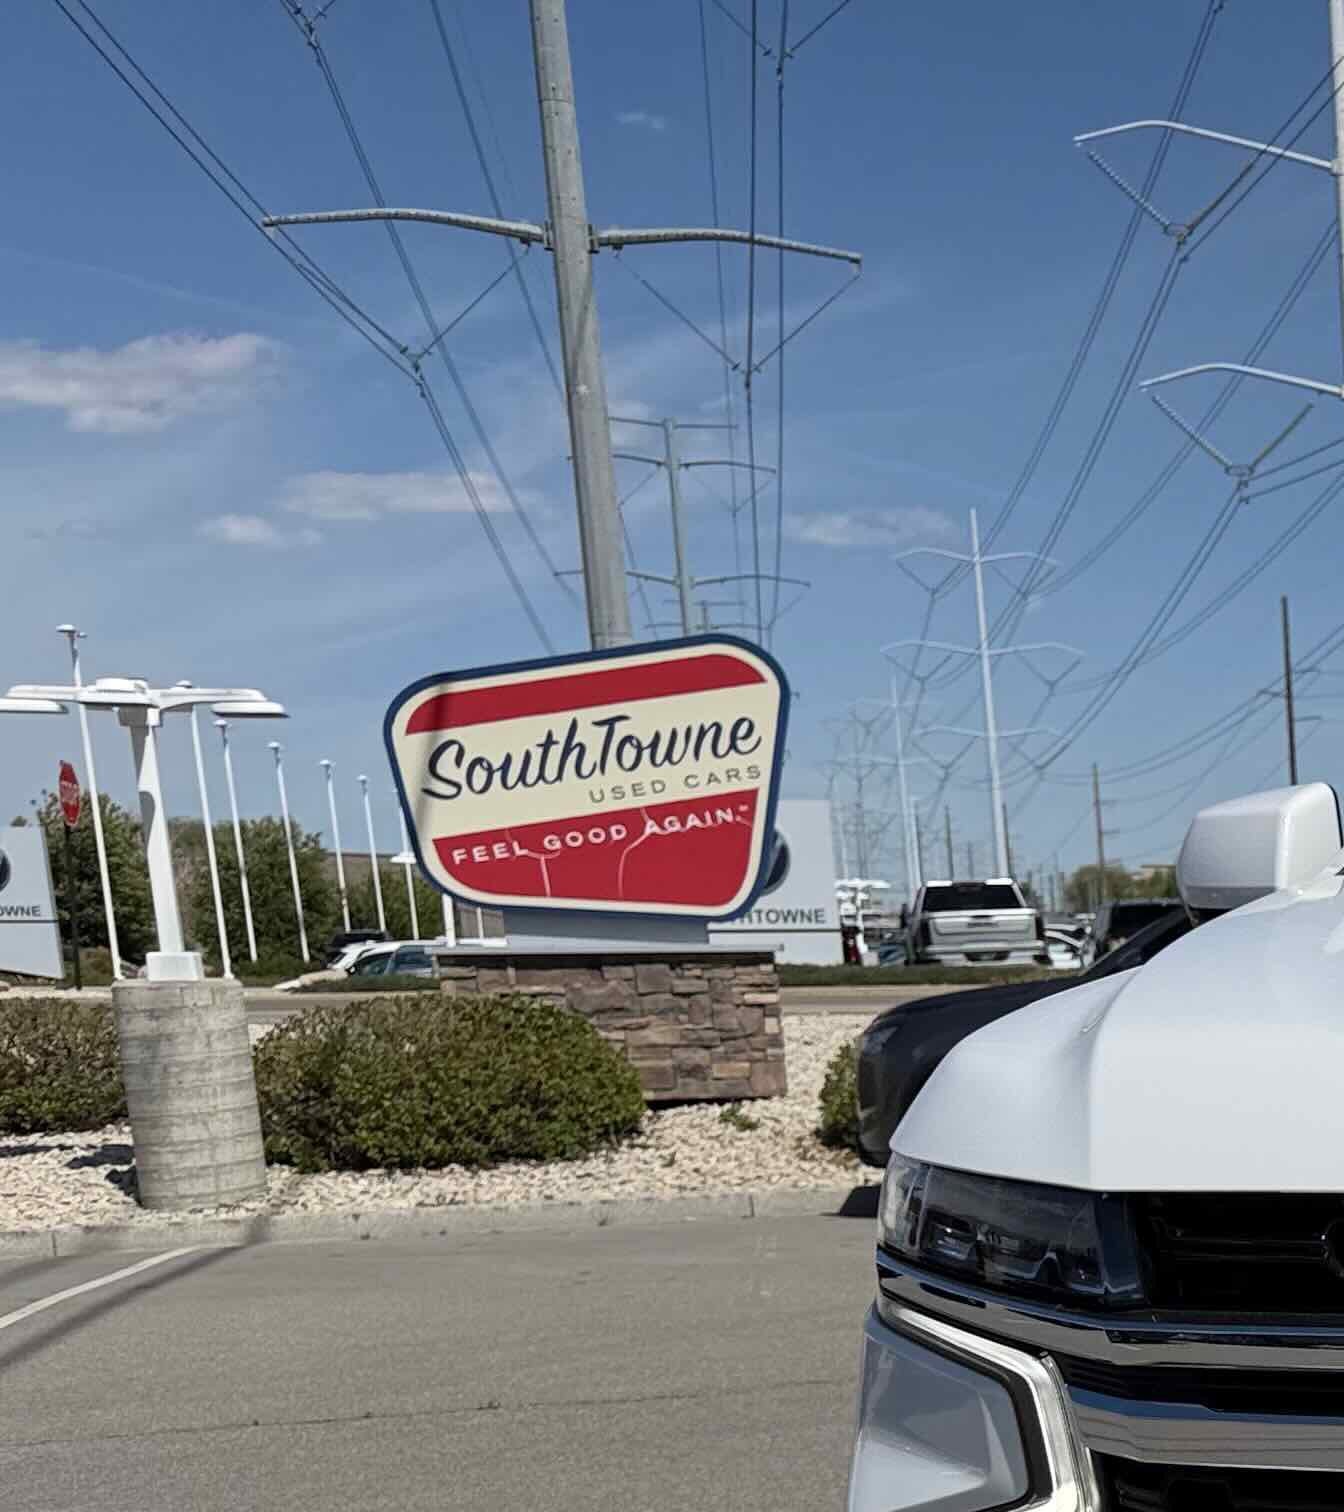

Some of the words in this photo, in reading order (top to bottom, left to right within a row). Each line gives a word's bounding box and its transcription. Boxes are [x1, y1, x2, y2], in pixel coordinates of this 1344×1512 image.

[588, 779, 667, 803] USED
[683, 764, 761, 788] CARS
[452, 840, 529, 865] FEEL
[543, 824, 627, 850] GOOD
